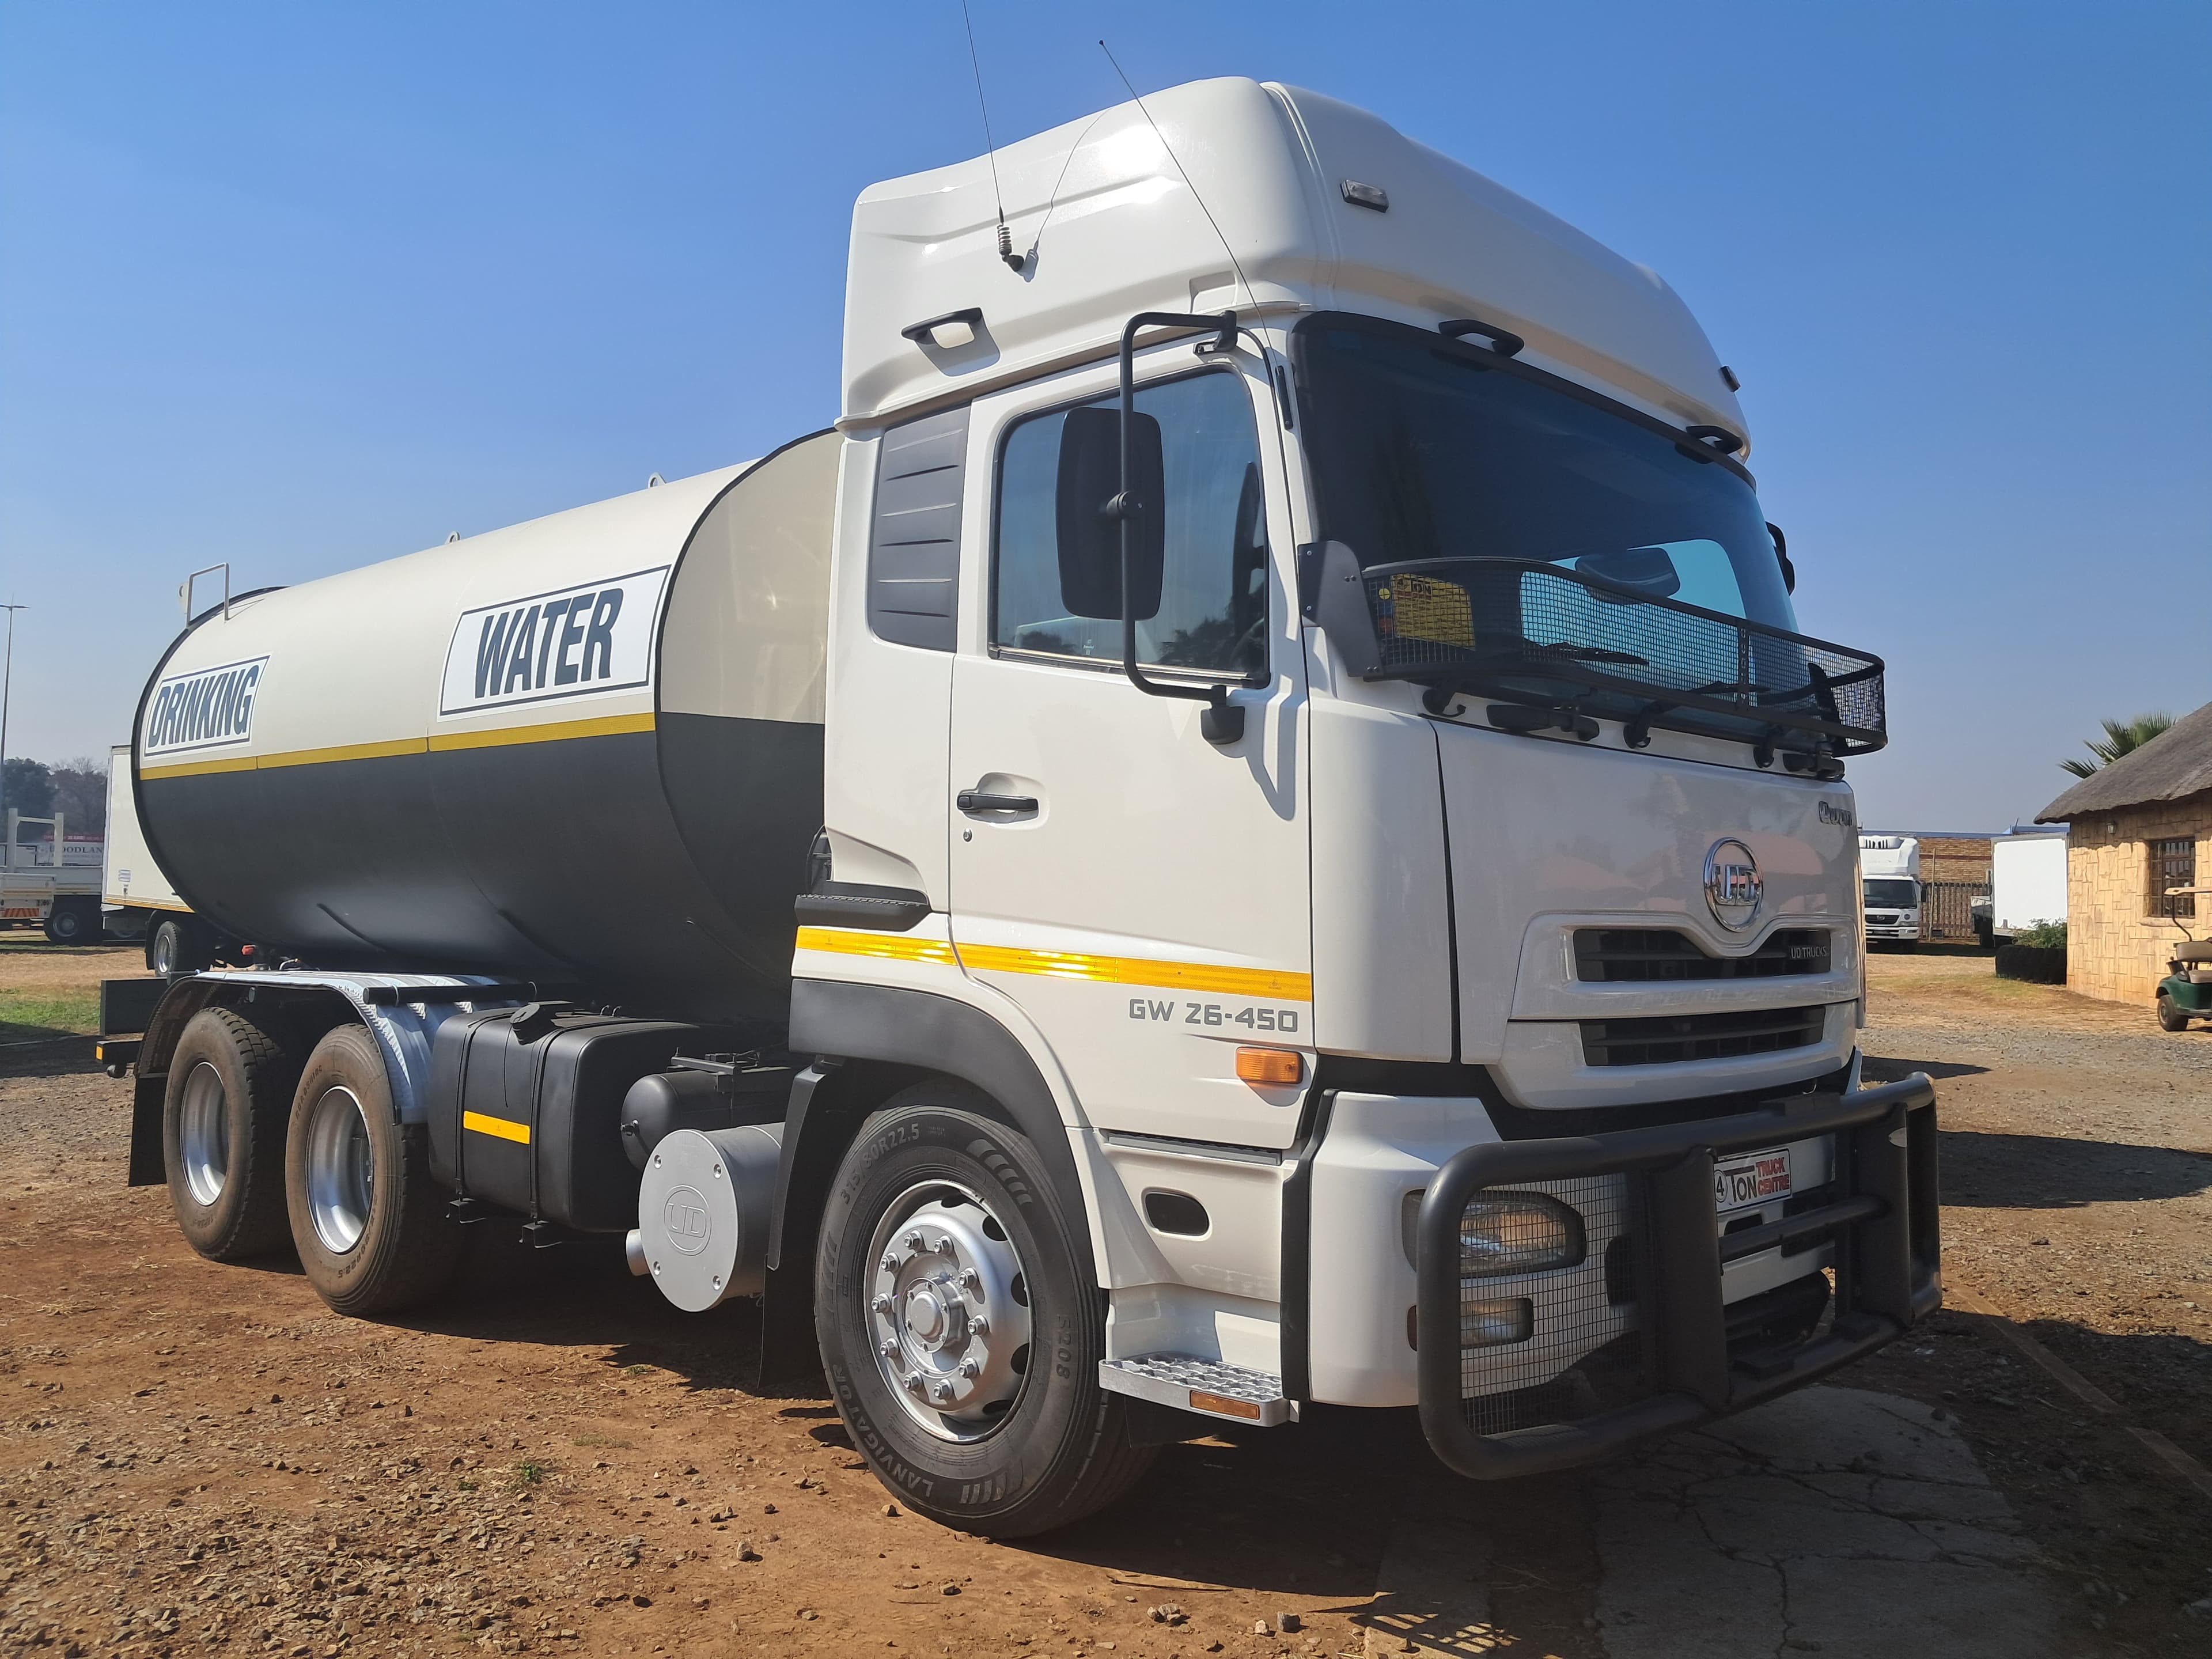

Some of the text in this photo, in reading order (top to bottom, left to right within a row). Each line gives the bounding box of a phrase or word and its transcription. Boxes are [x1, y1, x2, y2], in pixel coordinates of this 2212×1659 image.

[475, 588, 624, 699] WATER
[147, 665, 259, 748] DRINKING
[1791, 946, 1827, 959] UD TRUCKS
[1130, 999, 1298, 1033] GW 26-450
[840, 1123, 920, 1205] 315/80R22.5
[1756, 1157, 1785, 1177] TRUCK
[1716, 1165, 1757, 1202] 4 TON
[1758, 1174, 1790, 1196] CENTRE
[668, 1202, 706, 1238] UD
[834, 1364, 934, 1497] LANVIGATOR
